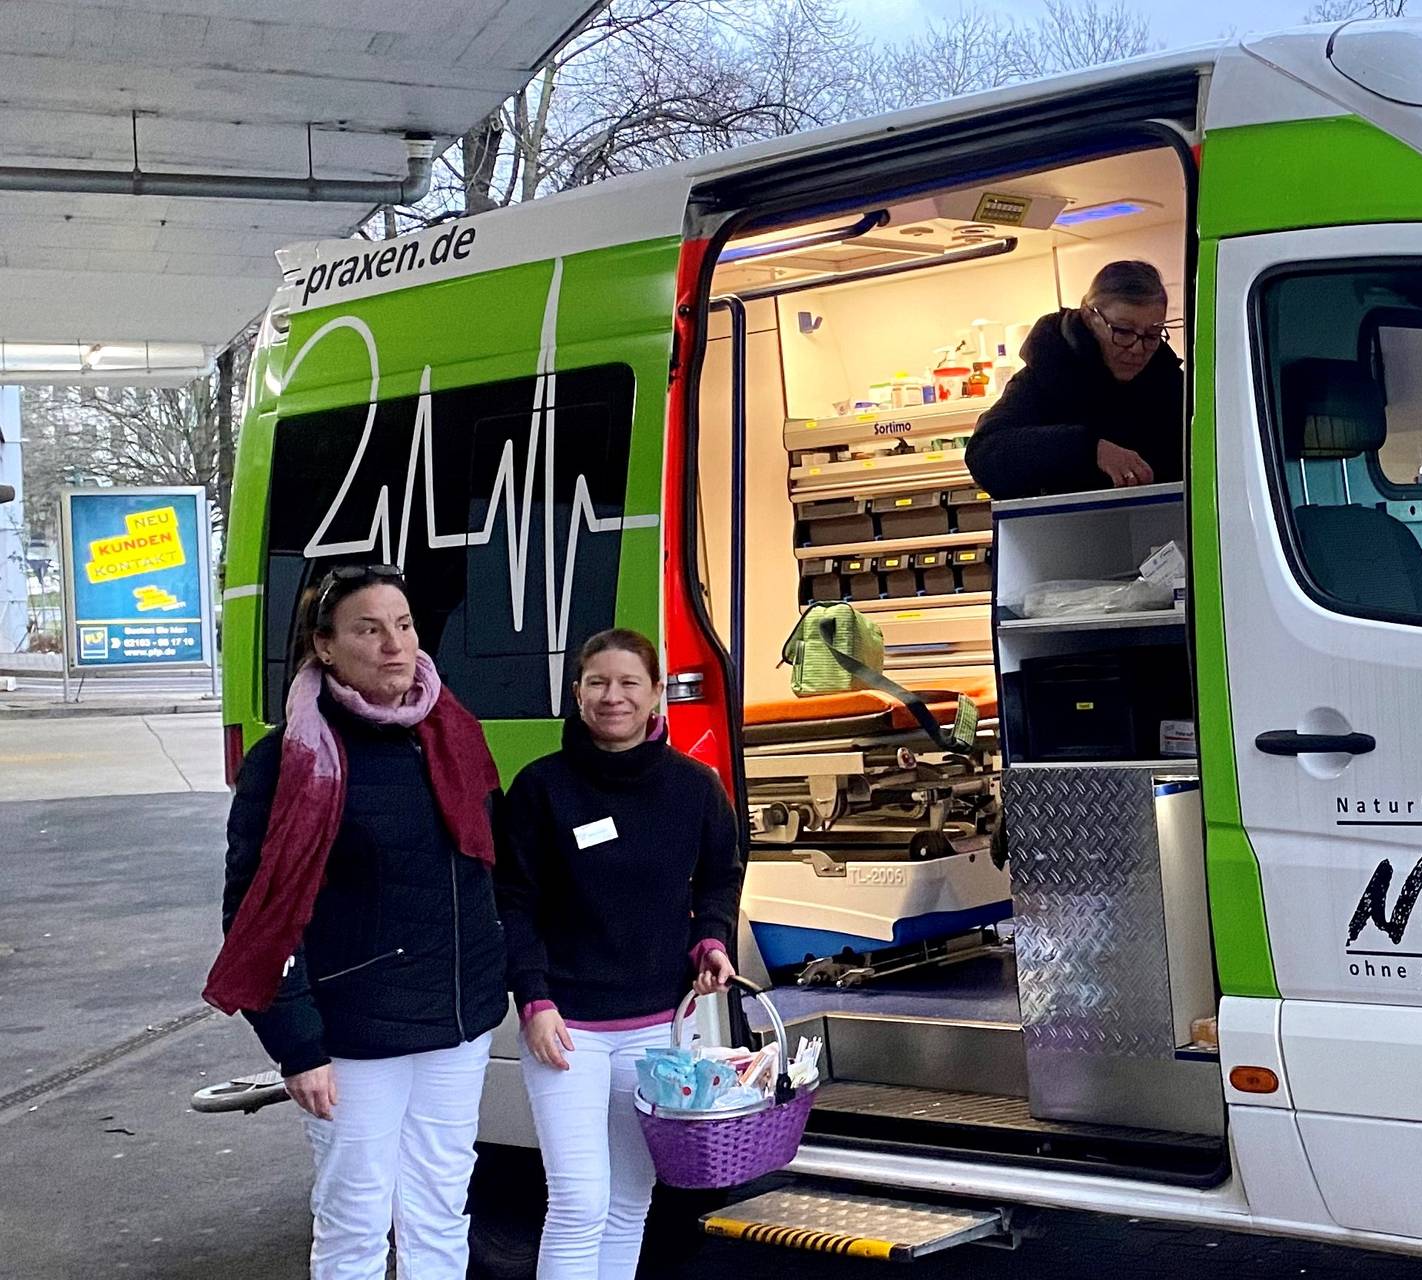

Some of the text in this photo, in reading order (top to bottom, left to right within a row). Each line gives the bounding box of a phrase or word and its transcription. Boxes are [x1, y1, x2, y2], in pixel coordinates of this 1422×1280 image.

[295, 225, 475, 306] -praxen.de
[874, 421, 911, 435] Sortimo
[134, 513, 169, 529] NEU
[98, 532, 173, 556] KUNDEN
[94, 551, 177, 577] KONTAKT
[848, 867, 904, 885] TL-2006
[1349, 960, 1407, 978] ohne
